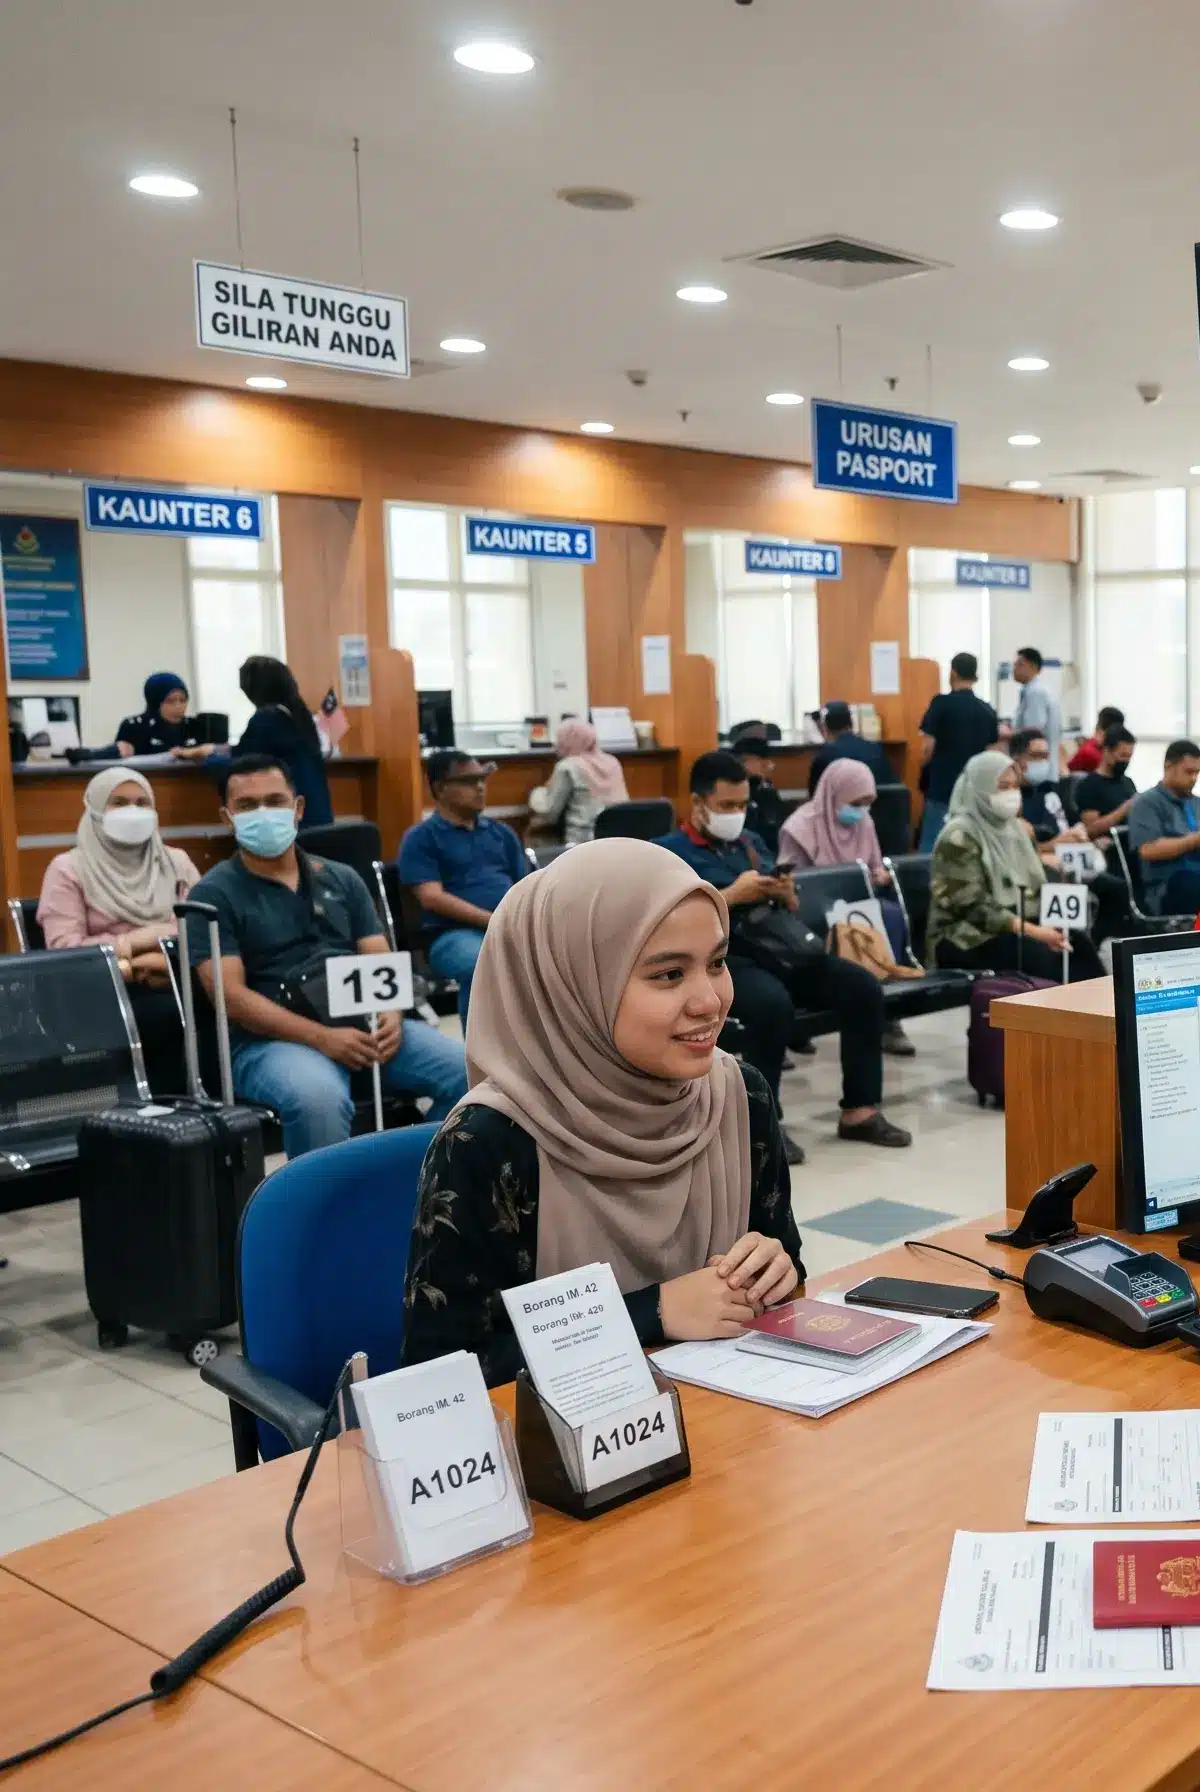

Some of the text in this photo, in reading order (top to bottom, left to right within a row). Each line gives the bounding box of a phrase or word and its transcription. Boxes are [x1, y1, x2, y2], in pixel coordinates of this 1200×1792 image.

[214, 280, 390, 330] SILA TUNGGU
[211, 312, 397, 361] GILIRAN ANDA
[840, 419, 932, 457] URUSAN
[836, 450, 937, 488] PASPORT
[98, 494, 253, 531] KAUNTER 6
[474, 526, 572, 554] KAUNTER
[750, 547, 823, 571] KAUNTER
[1046, 895, 1080, 920] A9
[343, 967, 399, 1003] 13
[523, 1282, 598, 1314] Borang IM. 42
[532, 1317, 568, 1334] Borang
[397, 1404, 435, 1423] Borang
[453, 1393, 466, 1404] 42
[592, 1411, 666, 1461] A1024
[410, 1451, 497, 1505] A1024
